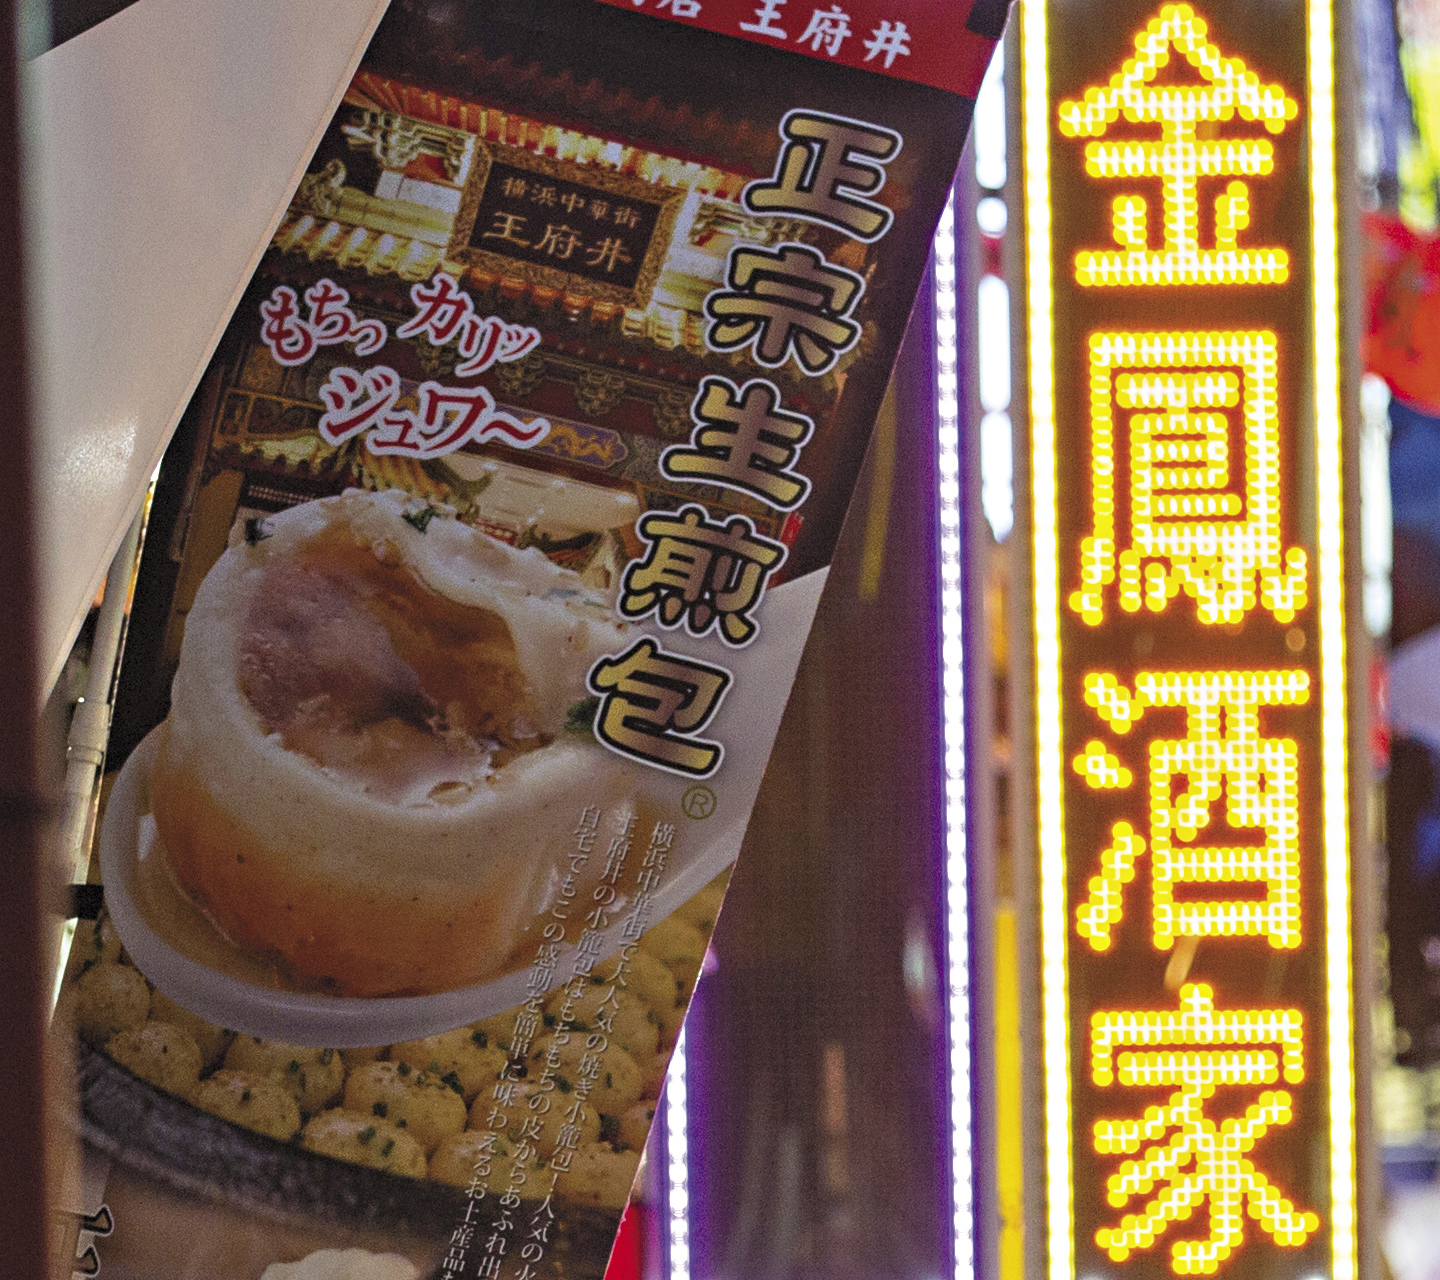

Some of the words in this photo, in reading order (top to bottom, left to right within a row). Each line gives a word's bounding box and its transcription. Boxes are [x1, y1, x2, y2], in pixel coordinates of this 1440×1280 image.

[740, 0, 912, 67] 王府井
[483, 211, 633, 272] 王府井
[260, 278, 388, 366] もちっ
[396, 272, 542, 377] カリッ
[587, 107, 904, 781] 正宗生煎包
[1057, 10, 1322, 1278] 金鳳酒家
